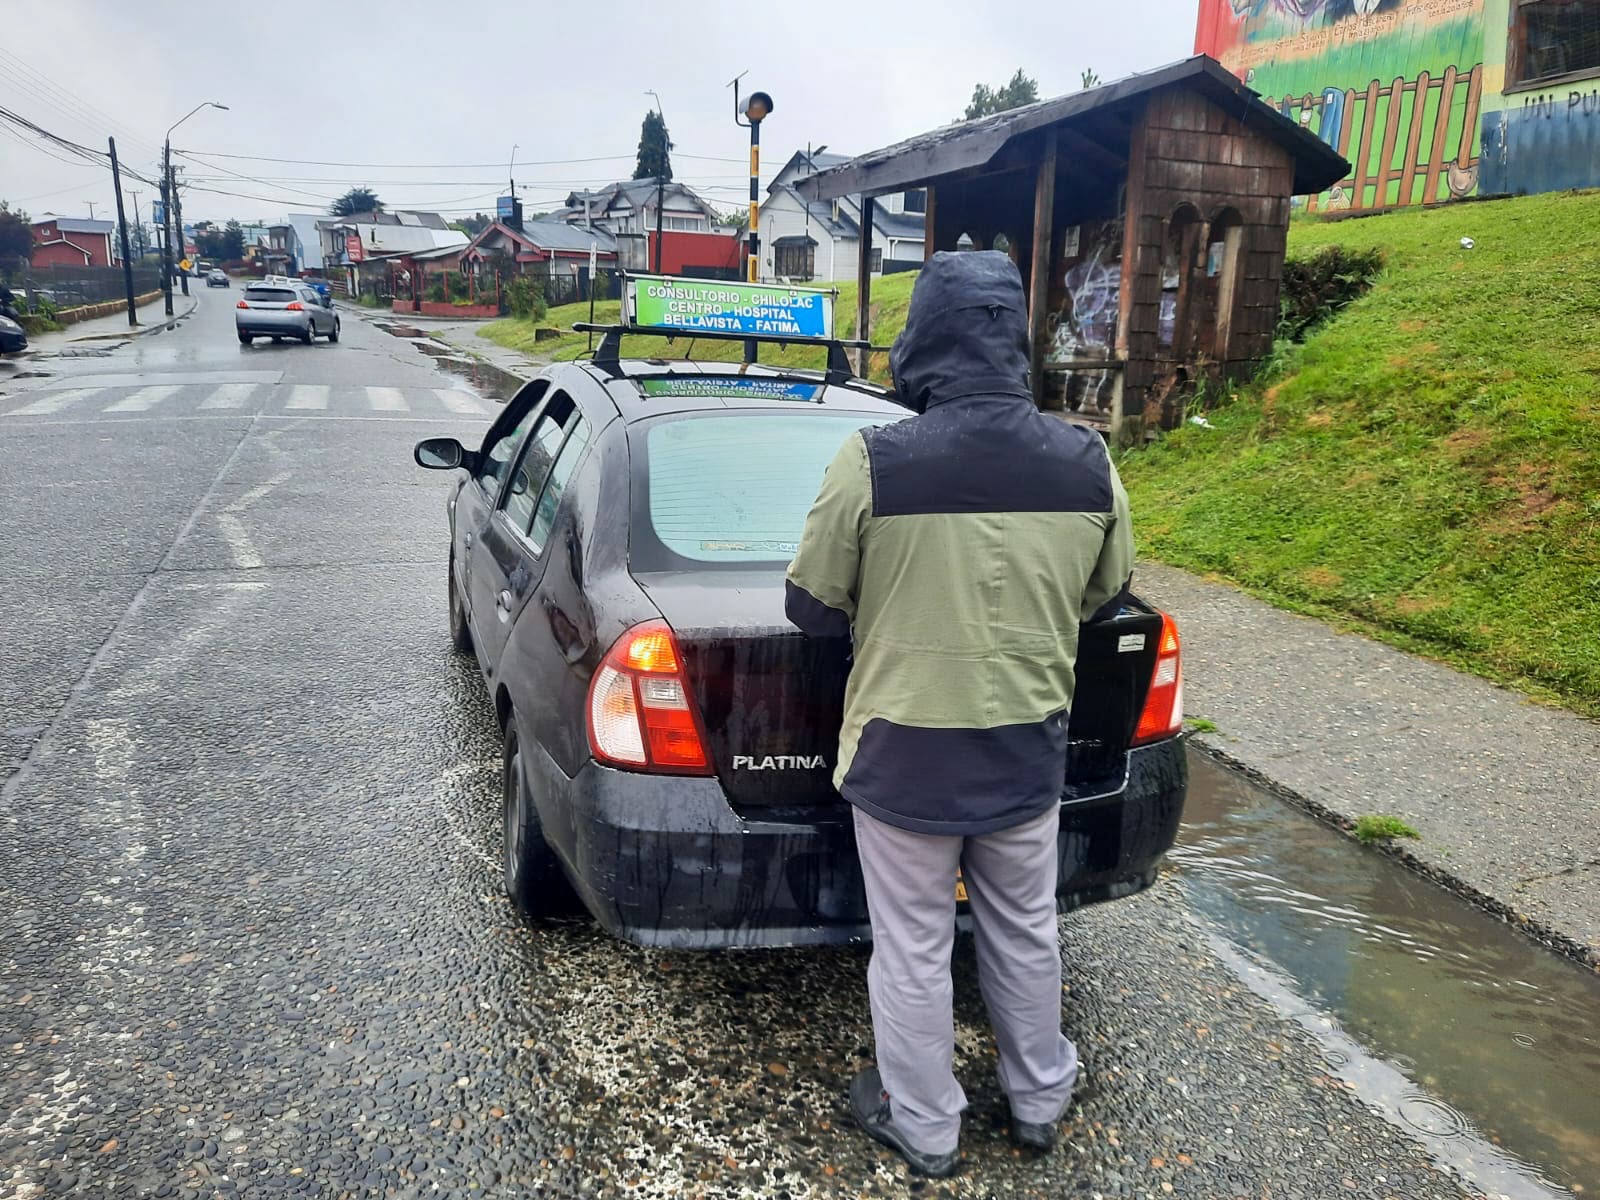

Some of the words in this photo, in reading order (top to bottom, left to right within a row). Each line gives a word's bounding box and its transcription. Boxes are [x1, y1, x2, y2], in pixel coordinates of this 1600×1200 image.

[1567, 89, 1600, 123] PU
[648, 286, 740, 303] CONSULTORIO
[752, 294, 813, 309] CHILOLAC
[669, 301, 723, 315] CENTRO
[734, 306, 795, 320] HOSPITAL
[663, 314, 742, 329] BELLAVISTA
[756, 320, 801, 333] FATIMA
[732, 755, 827, 770] PLATINA
